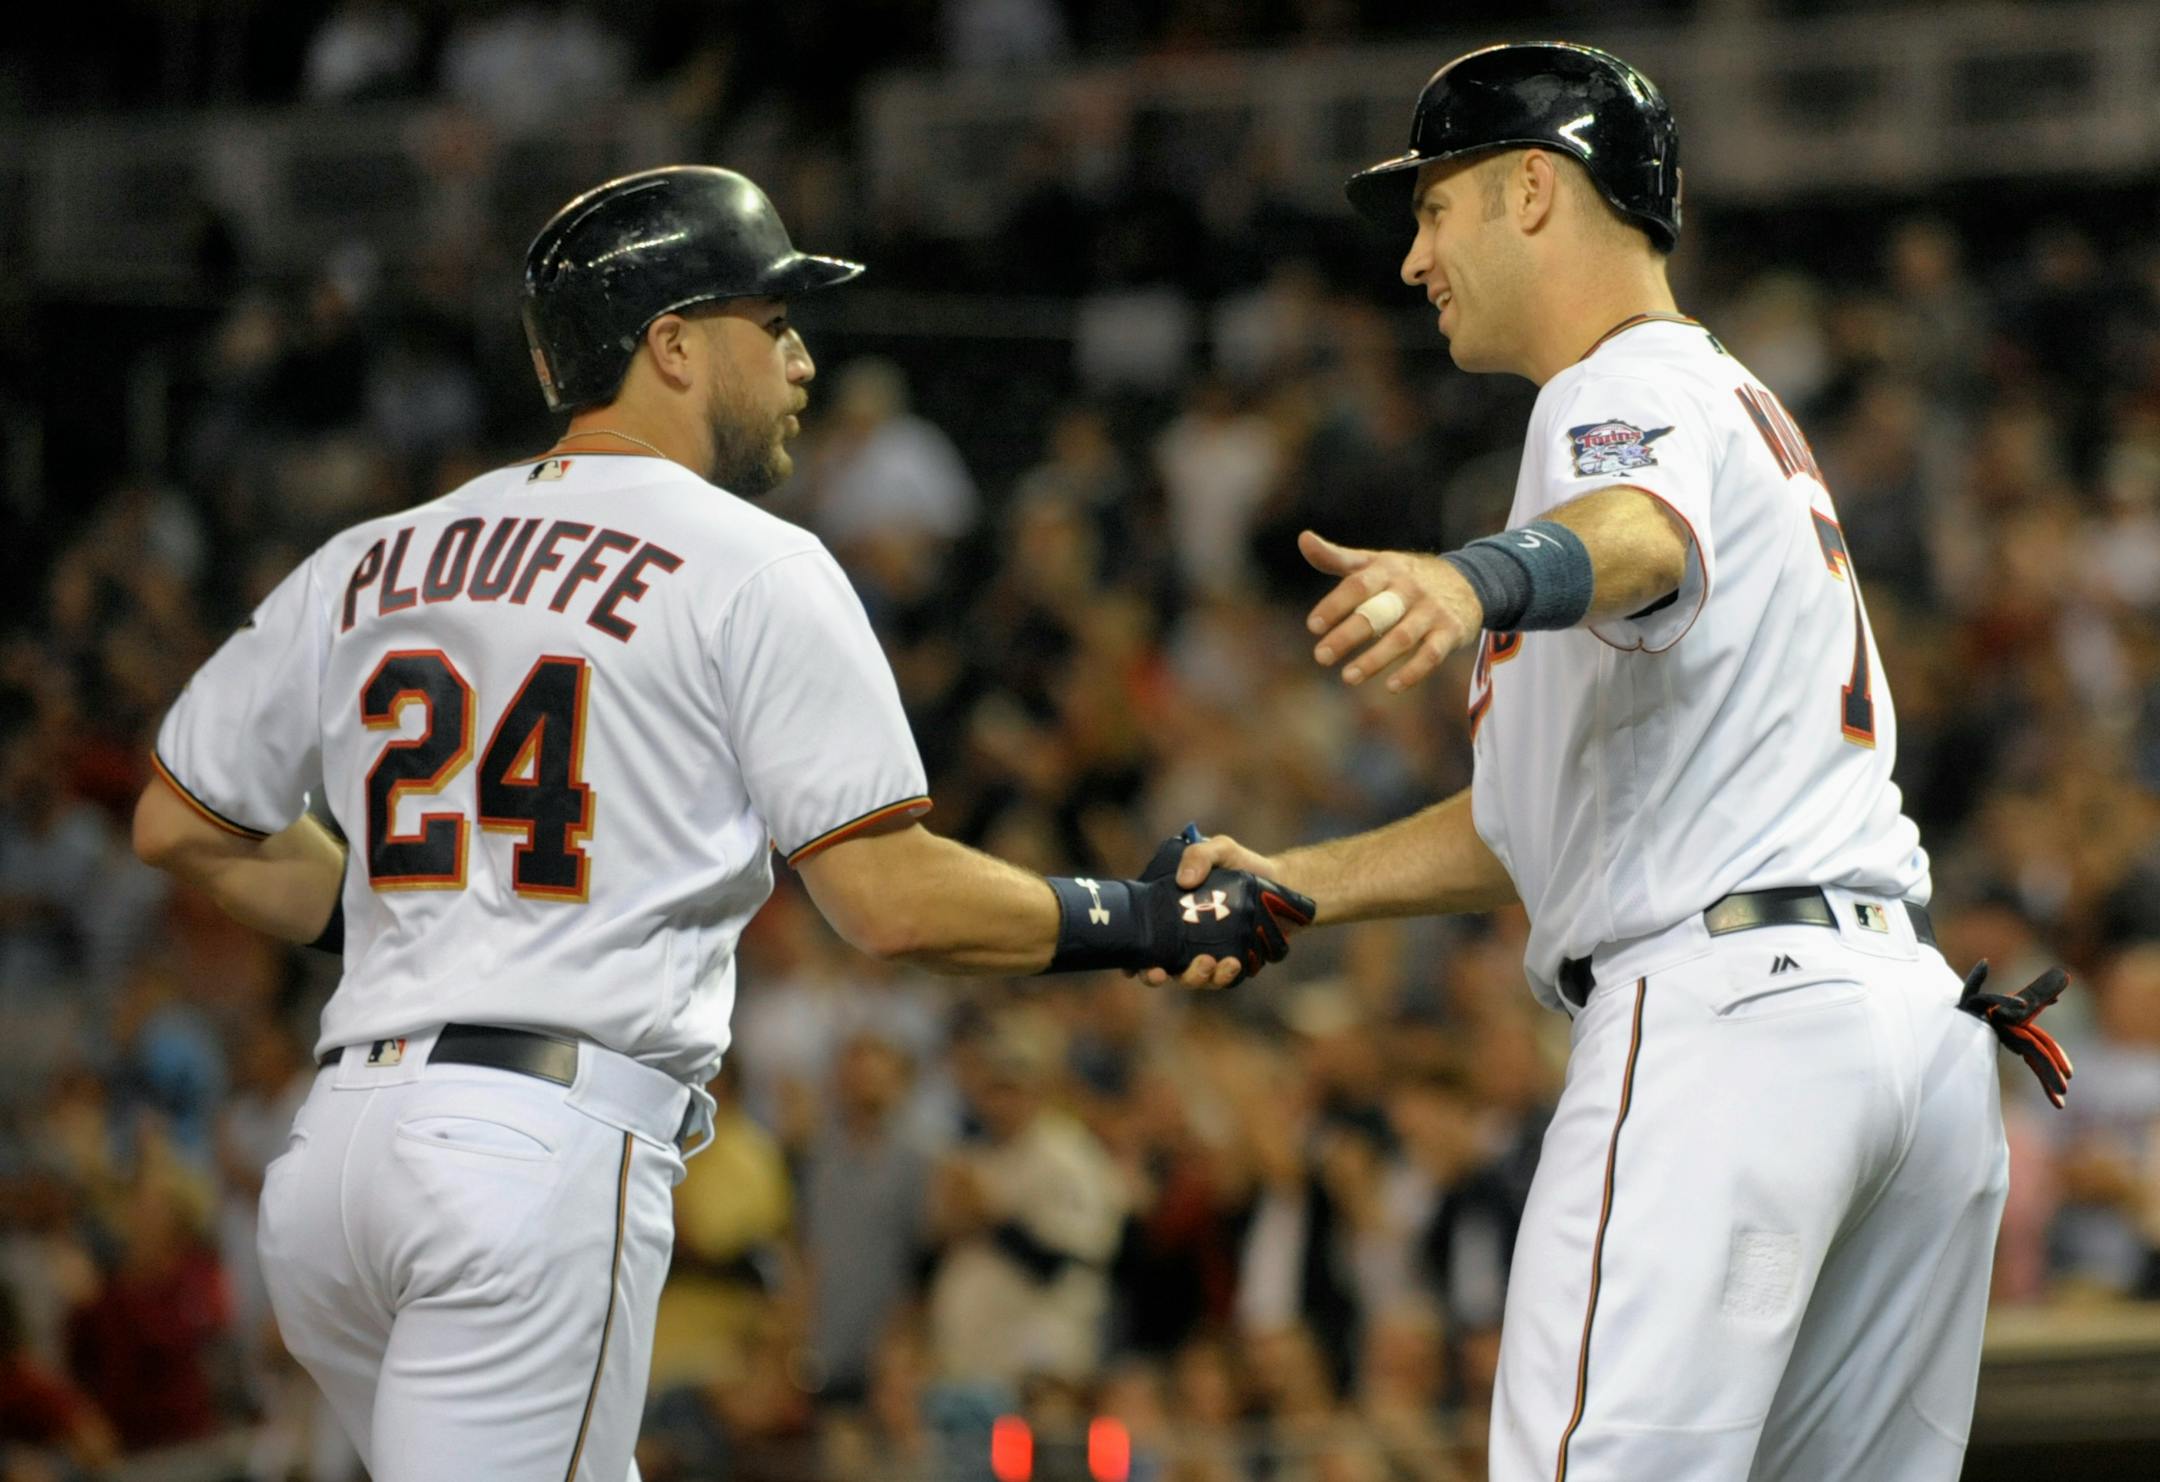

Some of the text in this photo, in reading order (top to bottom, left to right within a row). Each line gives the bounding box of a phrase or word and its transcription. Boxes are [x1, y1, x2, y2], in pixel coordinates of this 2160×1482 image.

[341, 517, 685, 643] PLOUFFE
[1811, 507, 1875, 750] 7
[360, 649, 597, 904] 24
